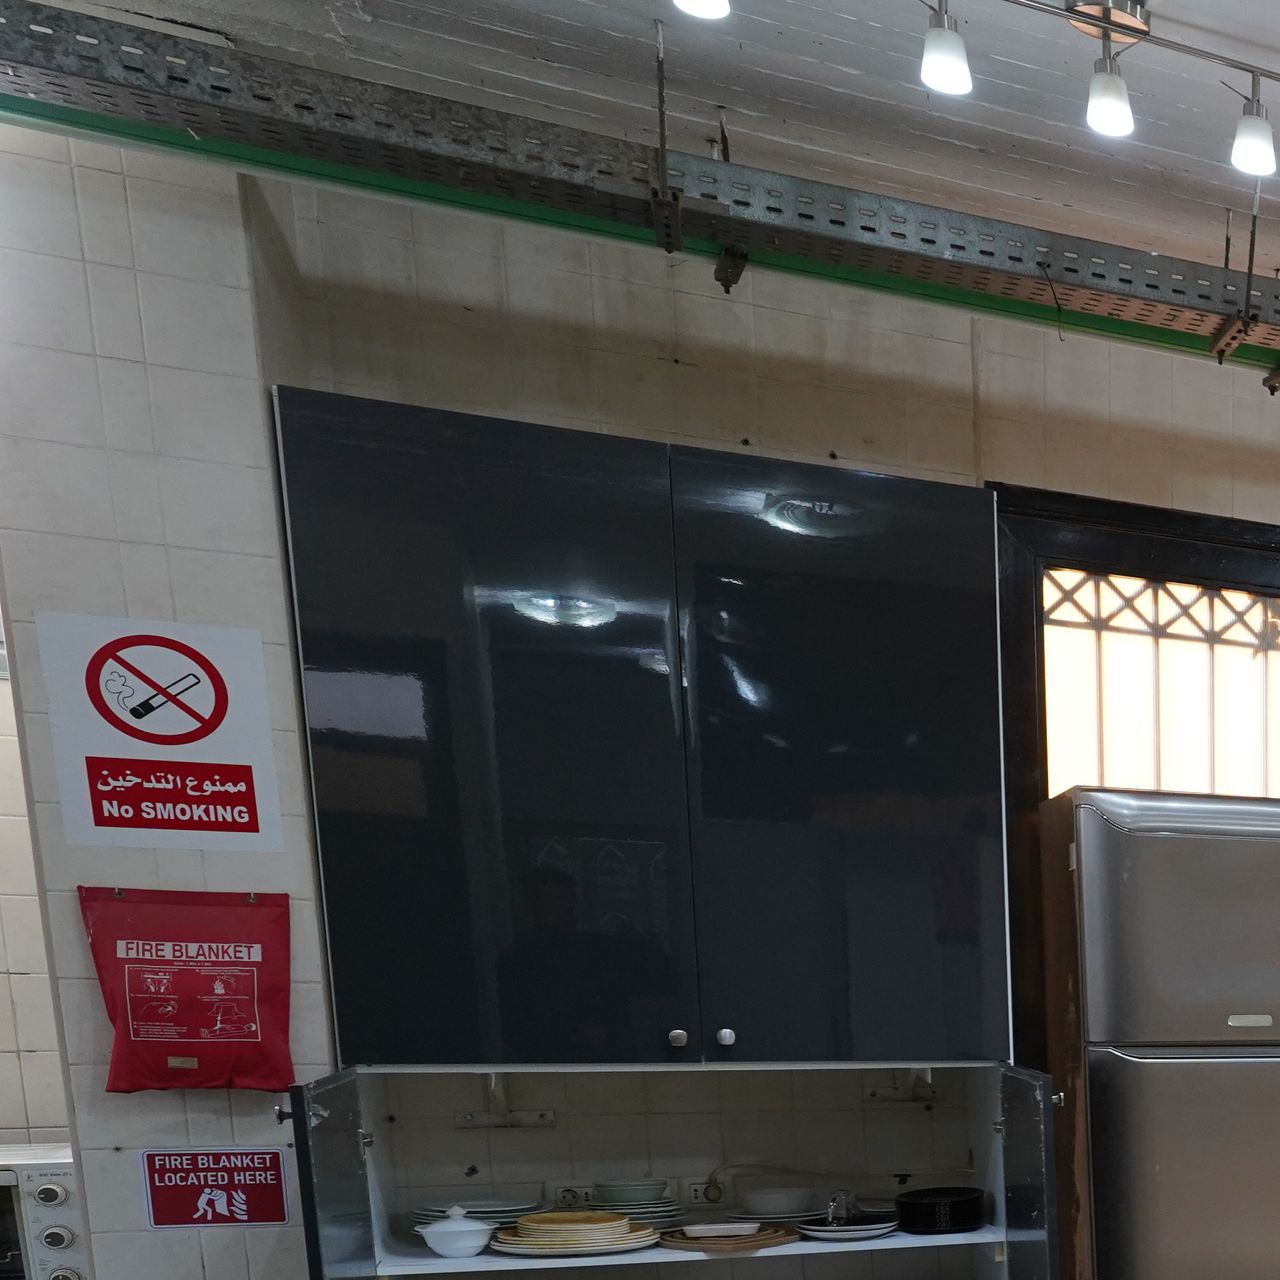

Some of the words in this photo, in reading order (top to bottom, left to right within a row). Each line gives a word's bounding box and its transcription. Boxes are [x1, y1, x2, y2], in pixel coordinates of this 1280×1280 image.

[96, 770, 182, 792] التدخين
[185, 774, 247, 796] ممنوع
[101, 799, 135, 818] No
[140, 801, 250, 824] SMOKING
[125, 941, 166, 958] FIRE
[171, 943, 255, 960] BLANKET
[155, 1155, 193, 1169] FIRE
[197, 1154, 273, 1169] BLANKET
[154, 1172, 229, 1186] LOCATED
[234, 1171, 277, 1184] HERE
